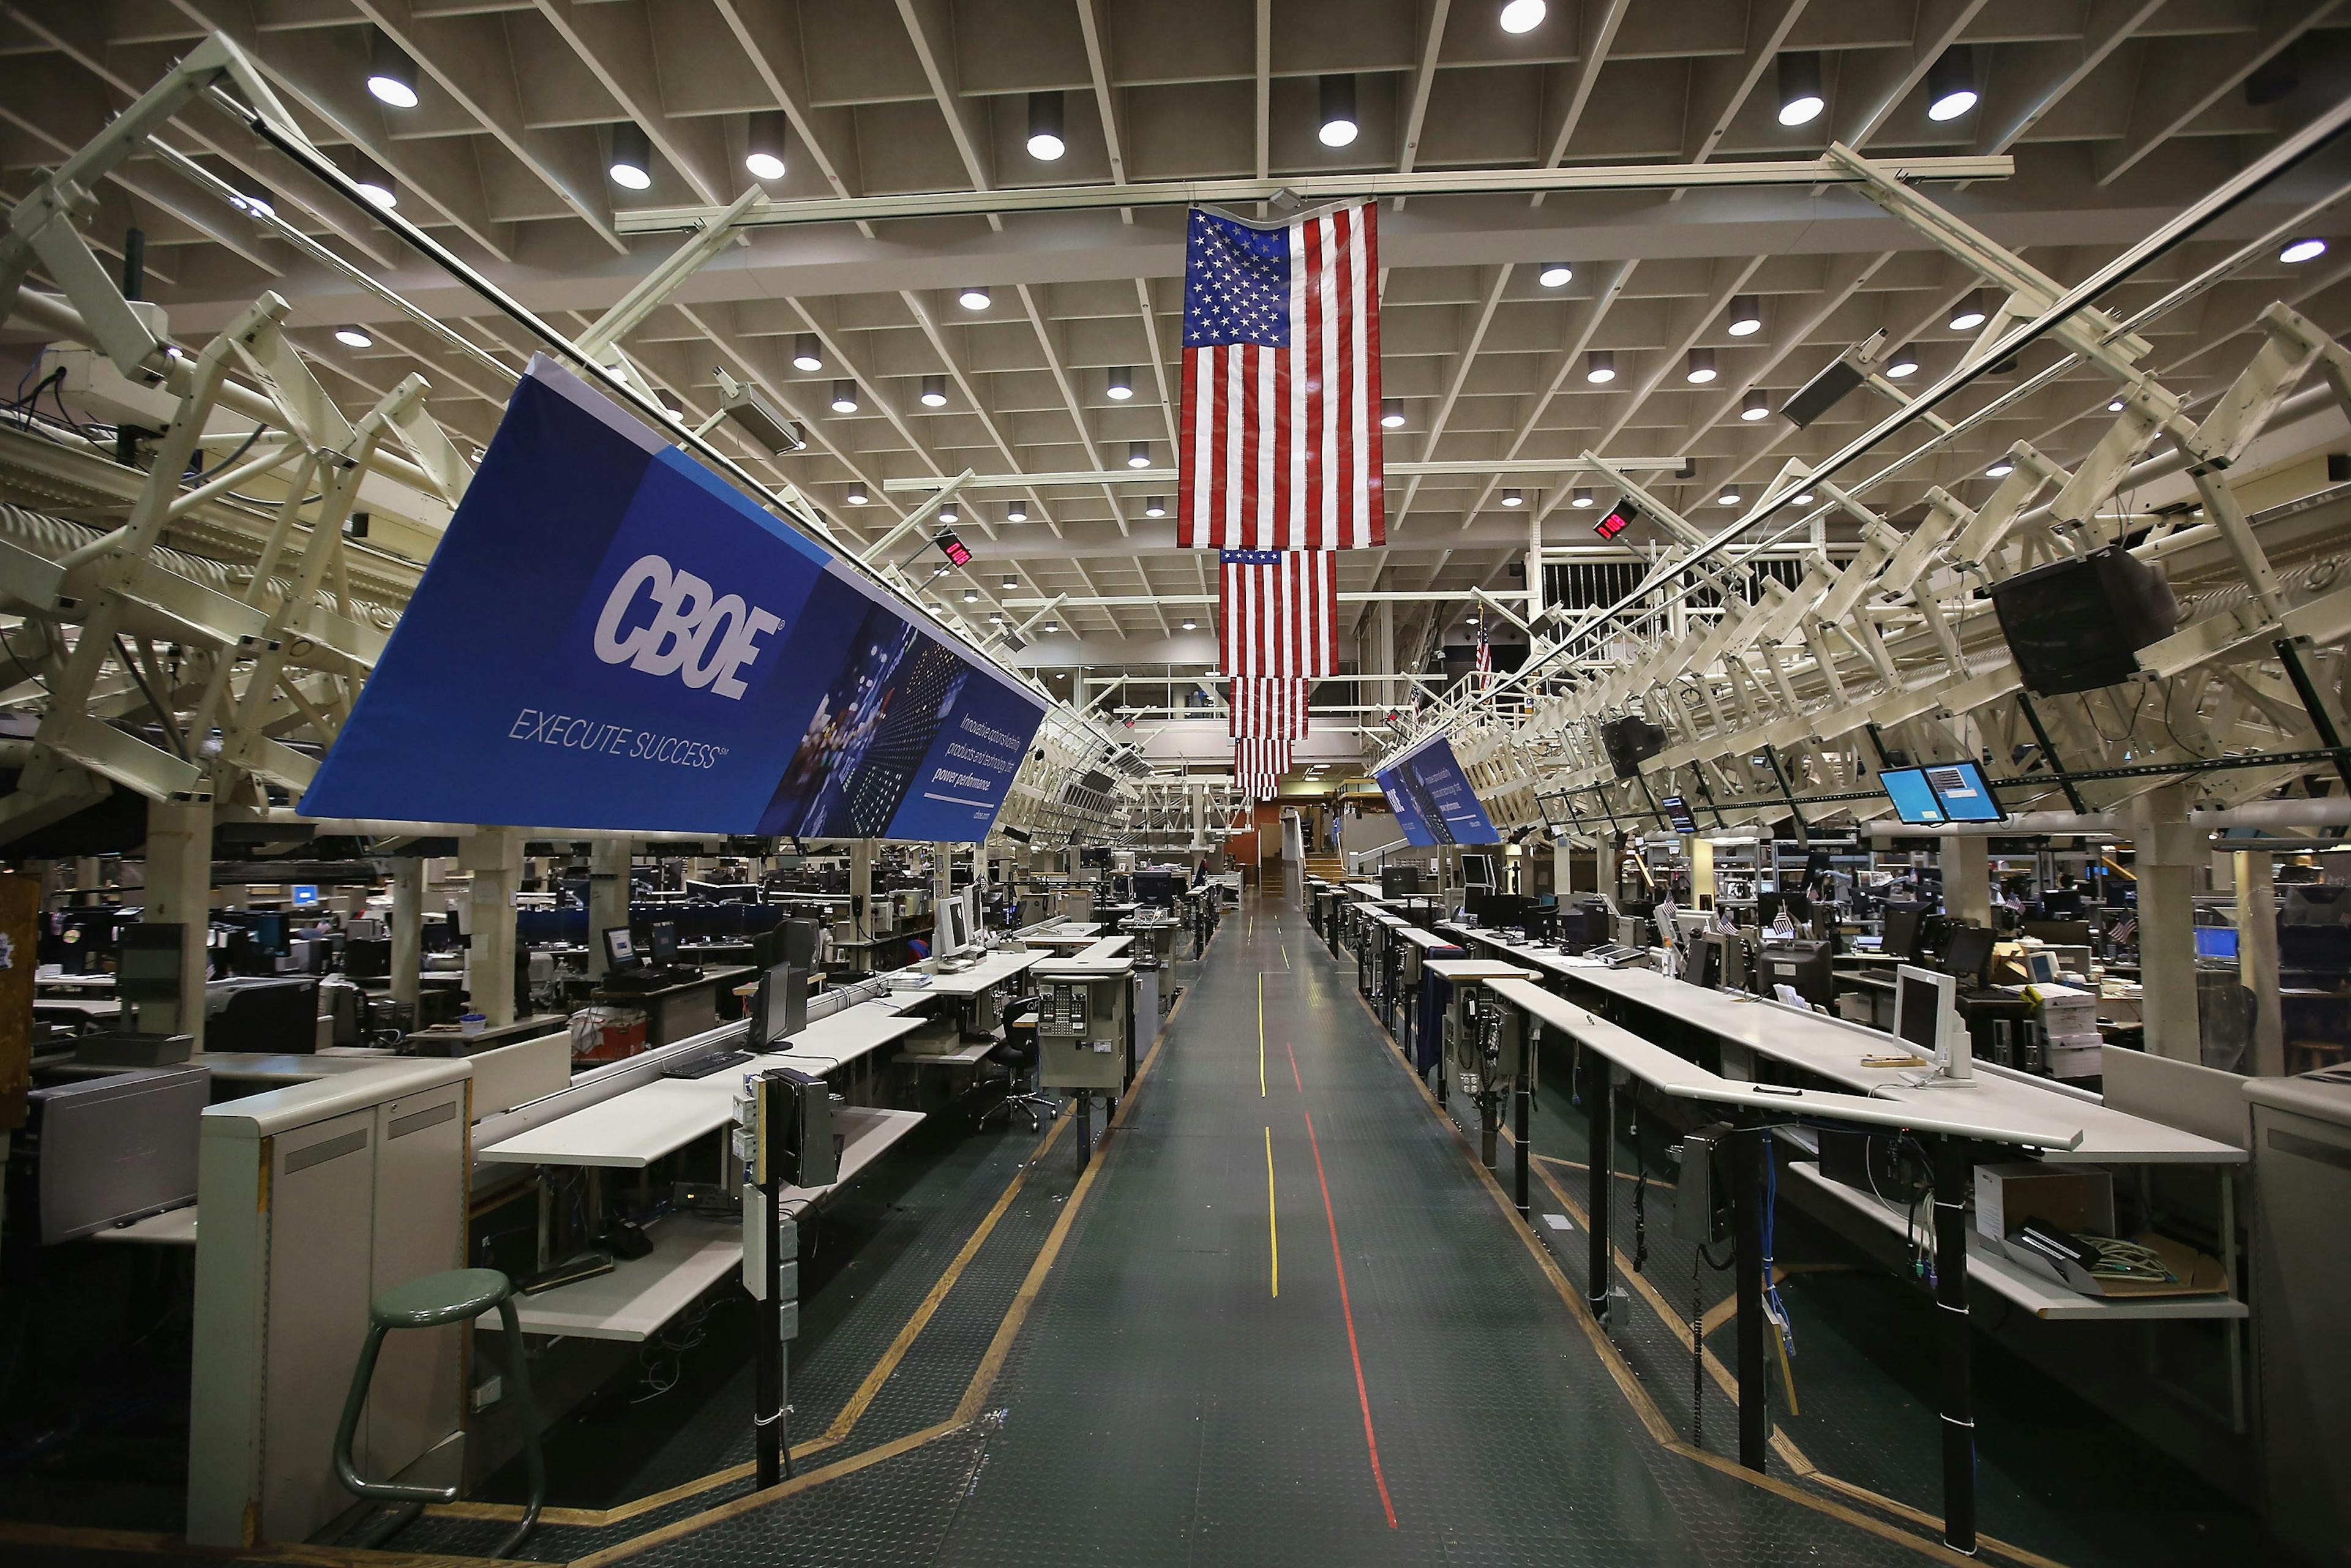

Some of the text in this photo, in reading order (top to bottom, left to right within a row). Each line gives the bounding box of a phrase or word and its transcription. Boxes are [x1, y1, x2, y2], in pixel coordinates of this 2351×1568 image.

[594, 555, 781, 700] CBOE
[508, 708, 632, 754] EXECUTE
[629, 732, 721, 768] SUCCESS
[960, 713, 991, 738] Innovative
[944, 742, 975, 762] products
[972, 751, 988, 765] and
[931, 768, 959, 784] power
